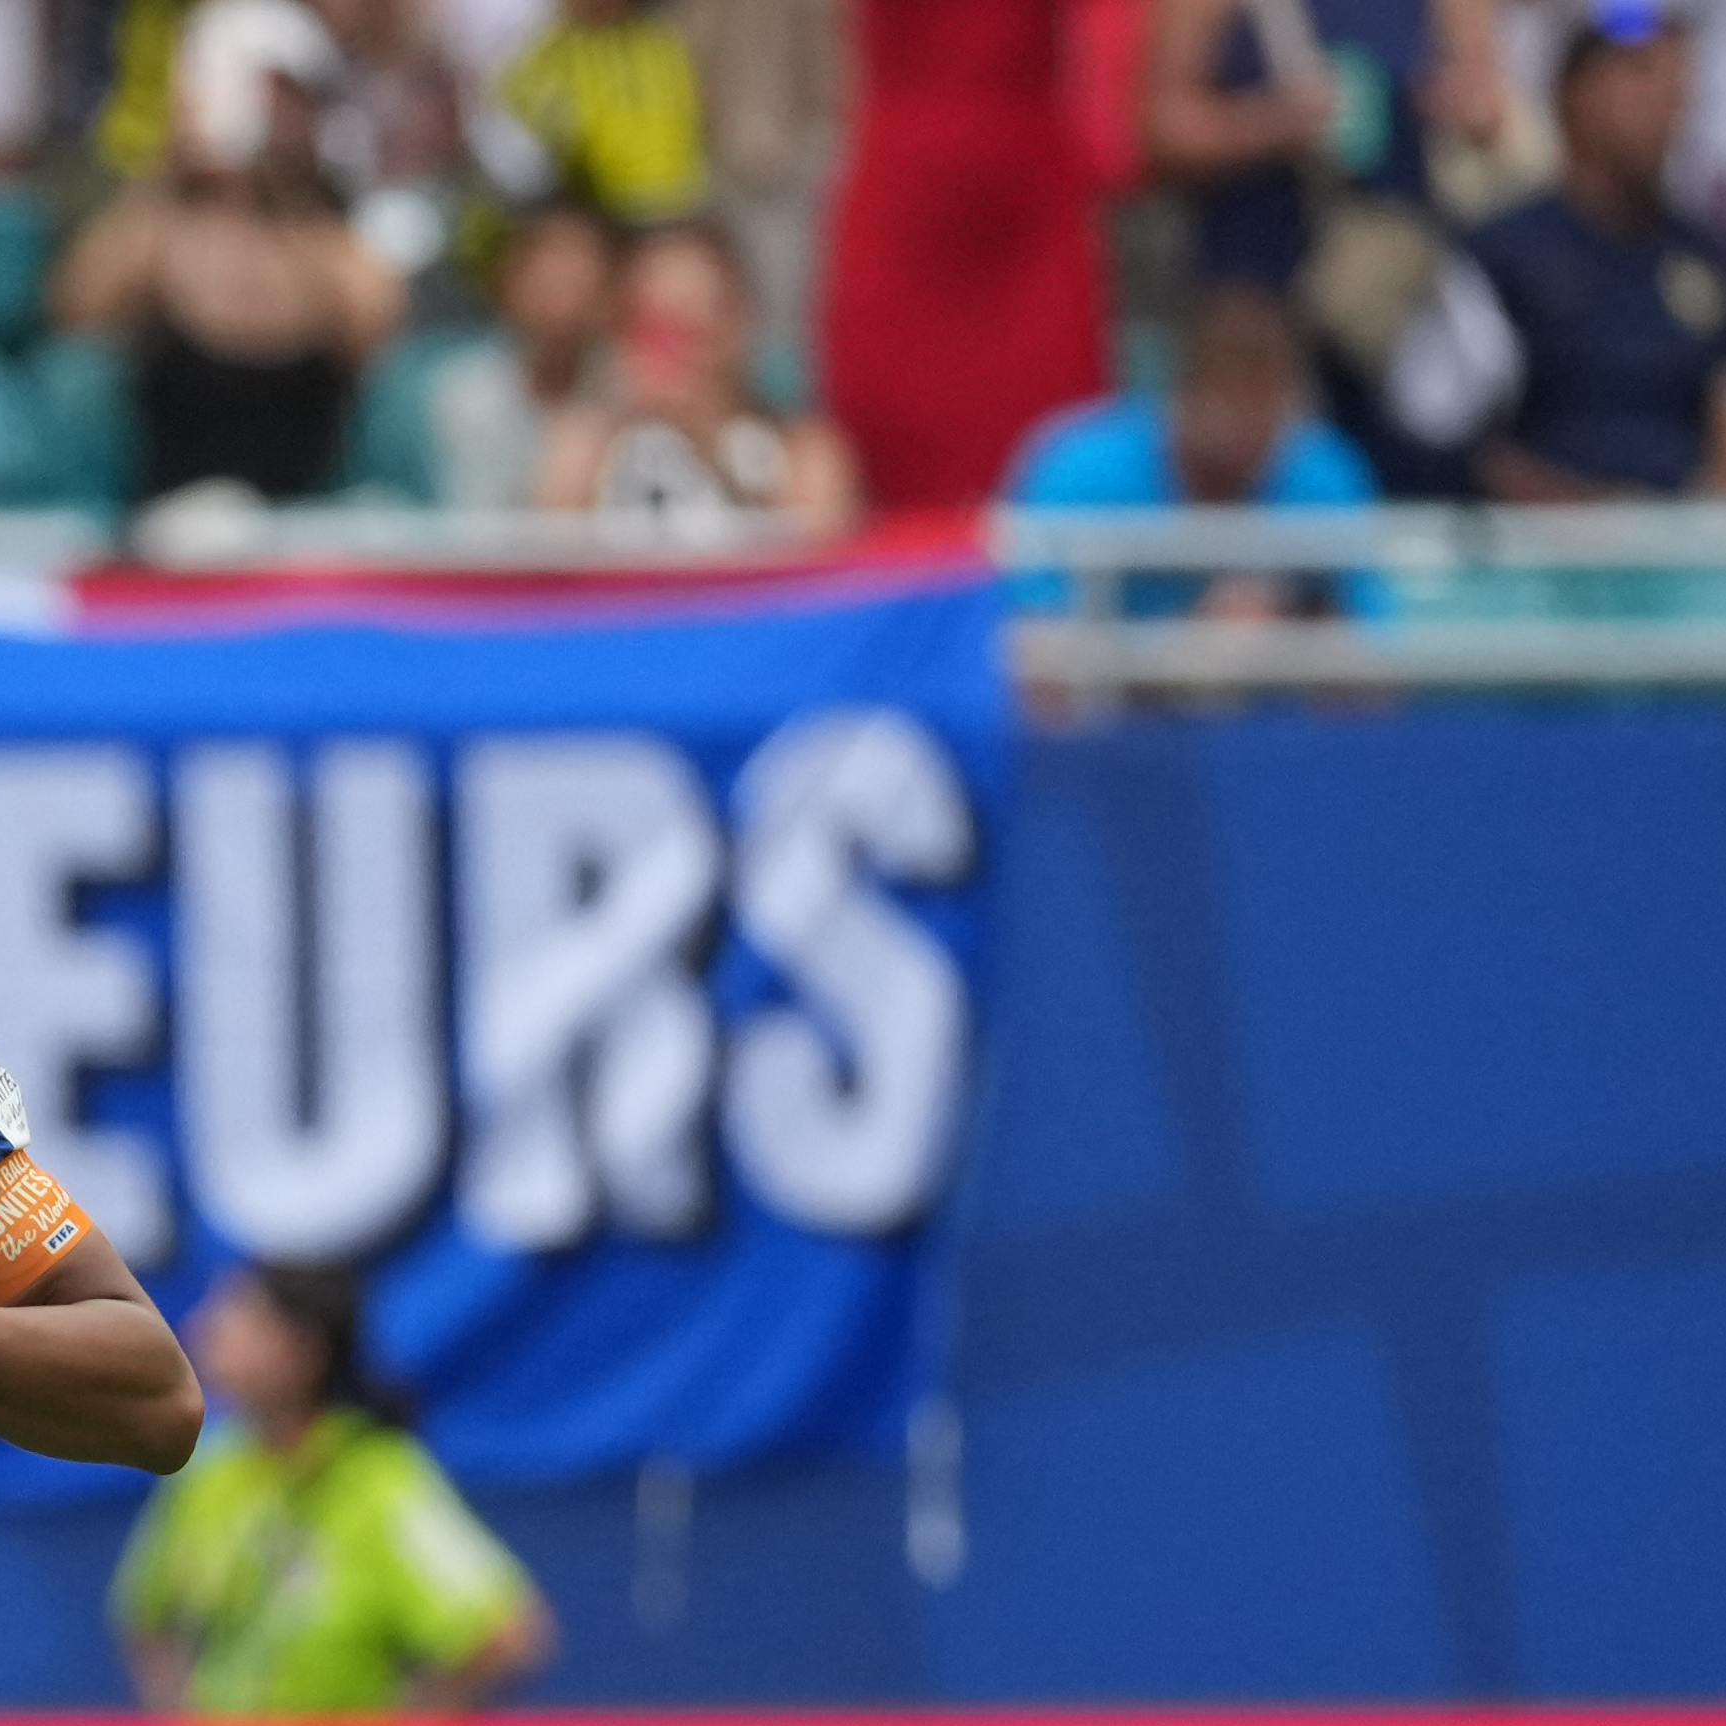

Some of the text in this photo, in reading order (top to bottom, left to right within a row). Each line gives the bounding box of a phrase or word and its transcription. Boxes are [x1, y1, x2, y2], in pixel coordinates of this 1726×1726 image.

[0, 1184, 71, 1261] the World
[48, 1223, 75, 1249] FIFA
